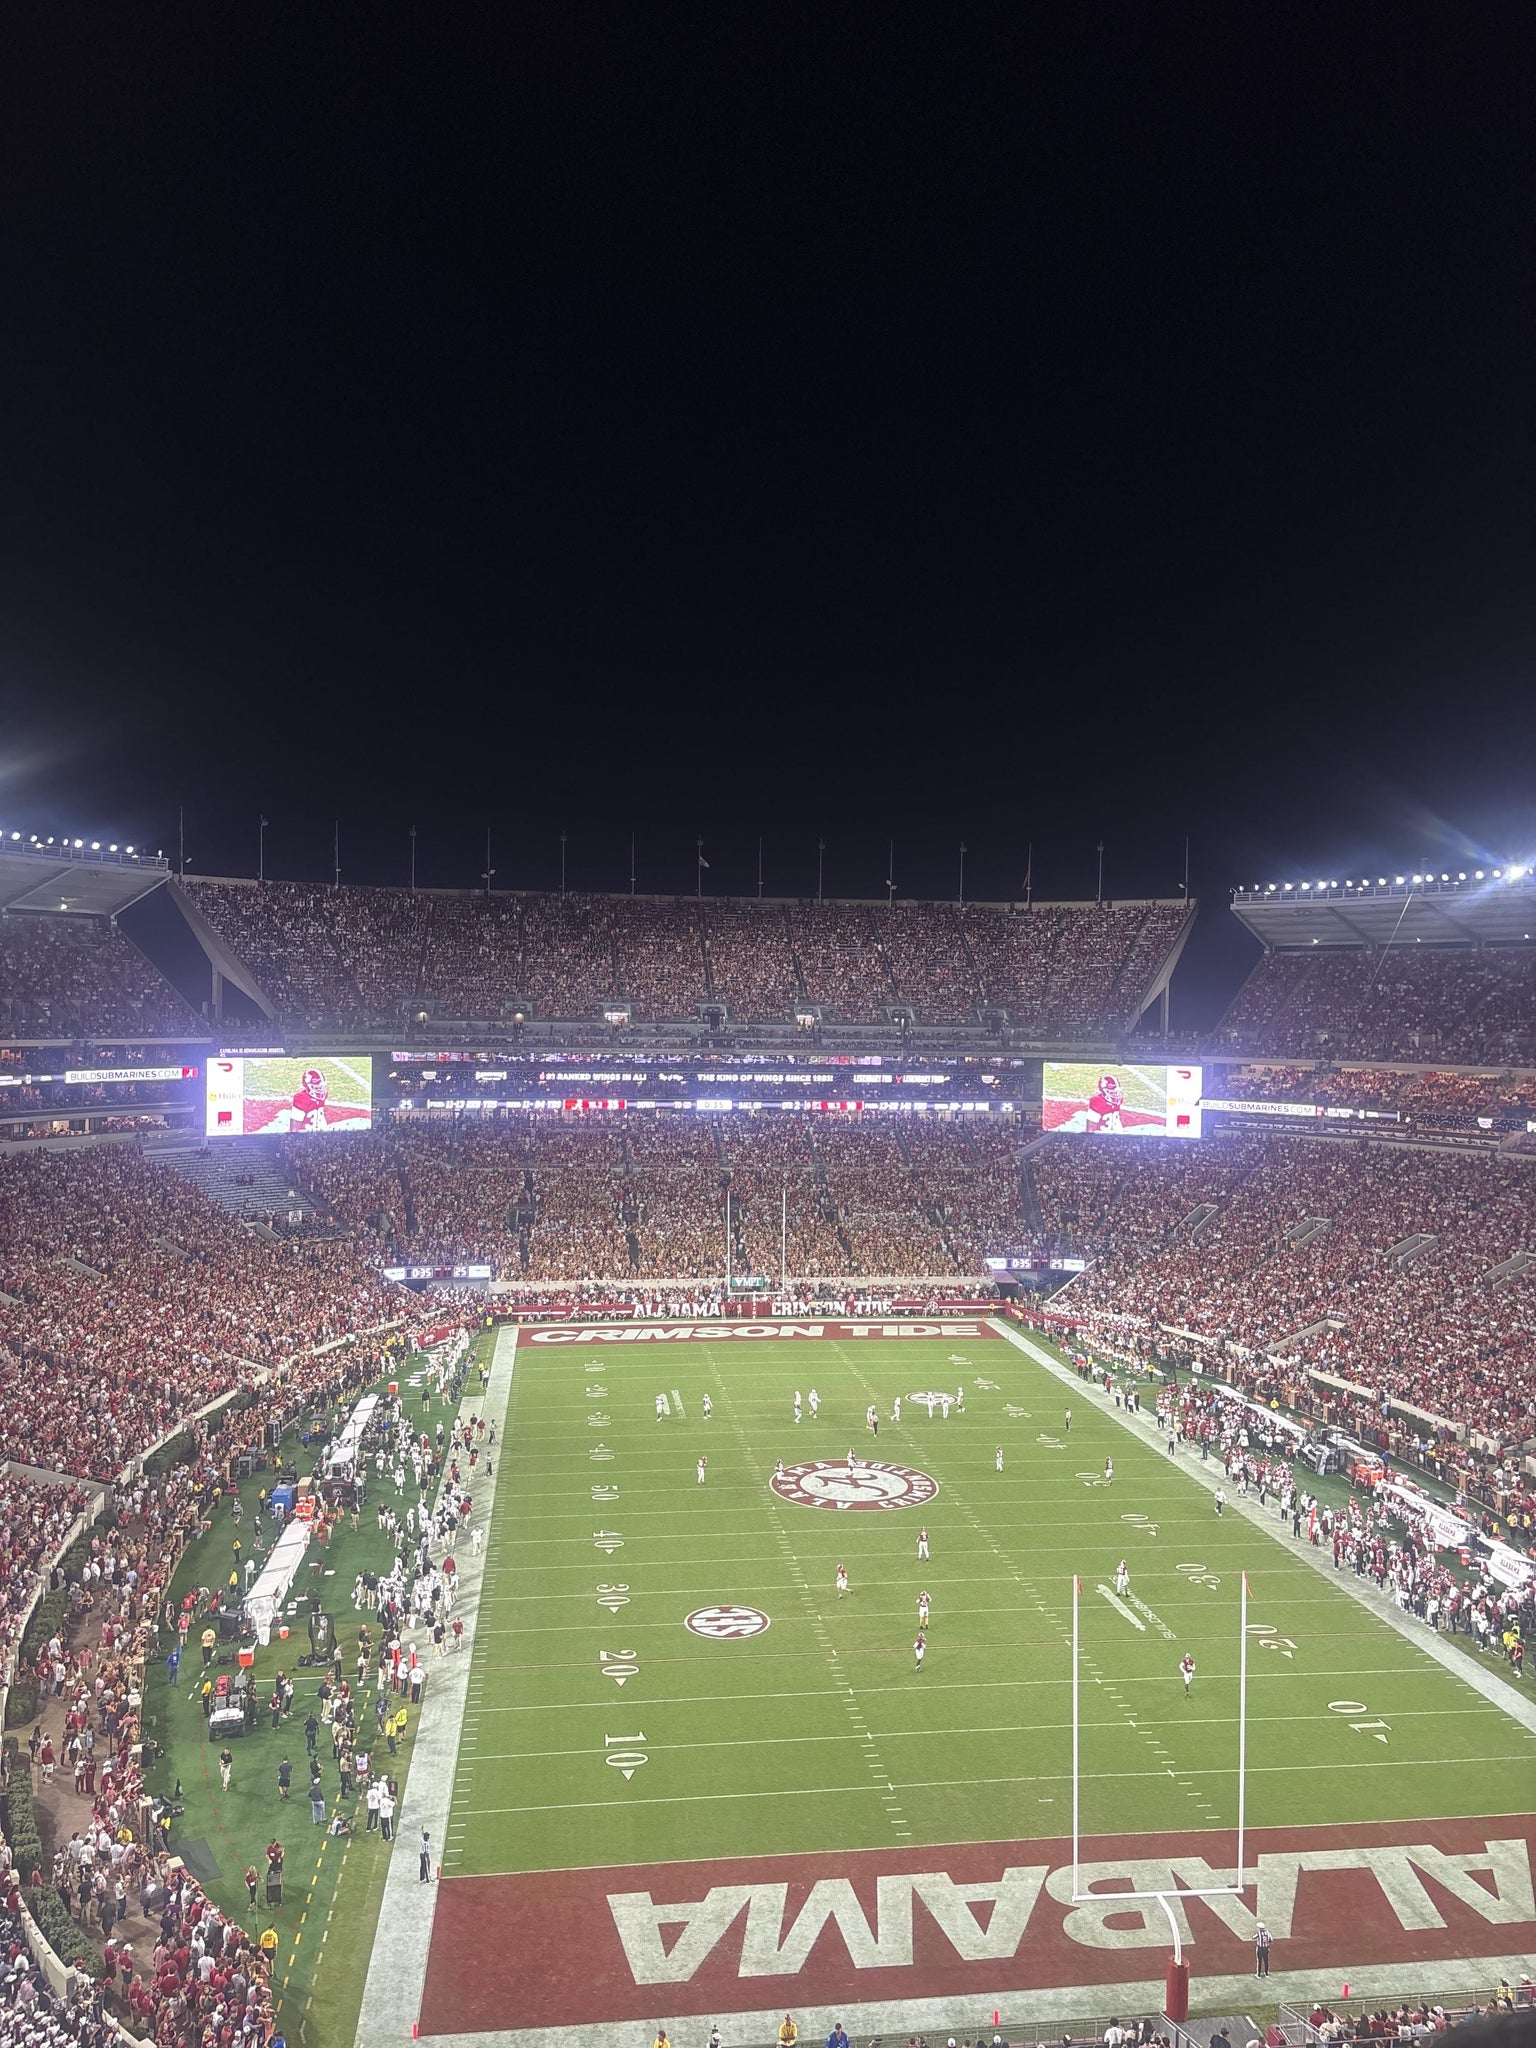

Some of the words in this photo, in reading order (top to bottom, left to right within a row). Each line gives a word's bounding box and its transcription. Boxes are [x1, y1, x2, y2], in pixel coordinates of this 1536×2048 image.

[70, 1070, 179, 1081] BUILDSUBMARINES.COM
[556, 1073, 591, 1081] RANKED
[593, 1073, 620, 1081] WINGS
[785, 1074, 811, 1082] SINCE
[1203, 1101, 1312, 1114] BUILDSUBMARINES.COM
[412, 1267, 431, 1278] 0:35
[455, 1267, 467, 1277] 25
[1012, 1259, 1030, 1269] 0:35
[531, 1325, 824, 1342] CRIMSON
[840, 1325, 981, 1336] TIDE
[591, 1485, 619, 1500] 50
[593, 1529, 625, 1548] 40
[1175, 1563, 1221, 1584] 30
[596, 1583, 630, 1605] 30
[690, 1607, 765, 1638] SEC
[1244, 1624, 1299, 1650] 20
[600, 1649, 640, 1676] 20
[1327, 1700, 1392, 1733] 10
[605, 1731, 648, 1767] 10
[607, 1839, 1536, 1985] ALABAMA
